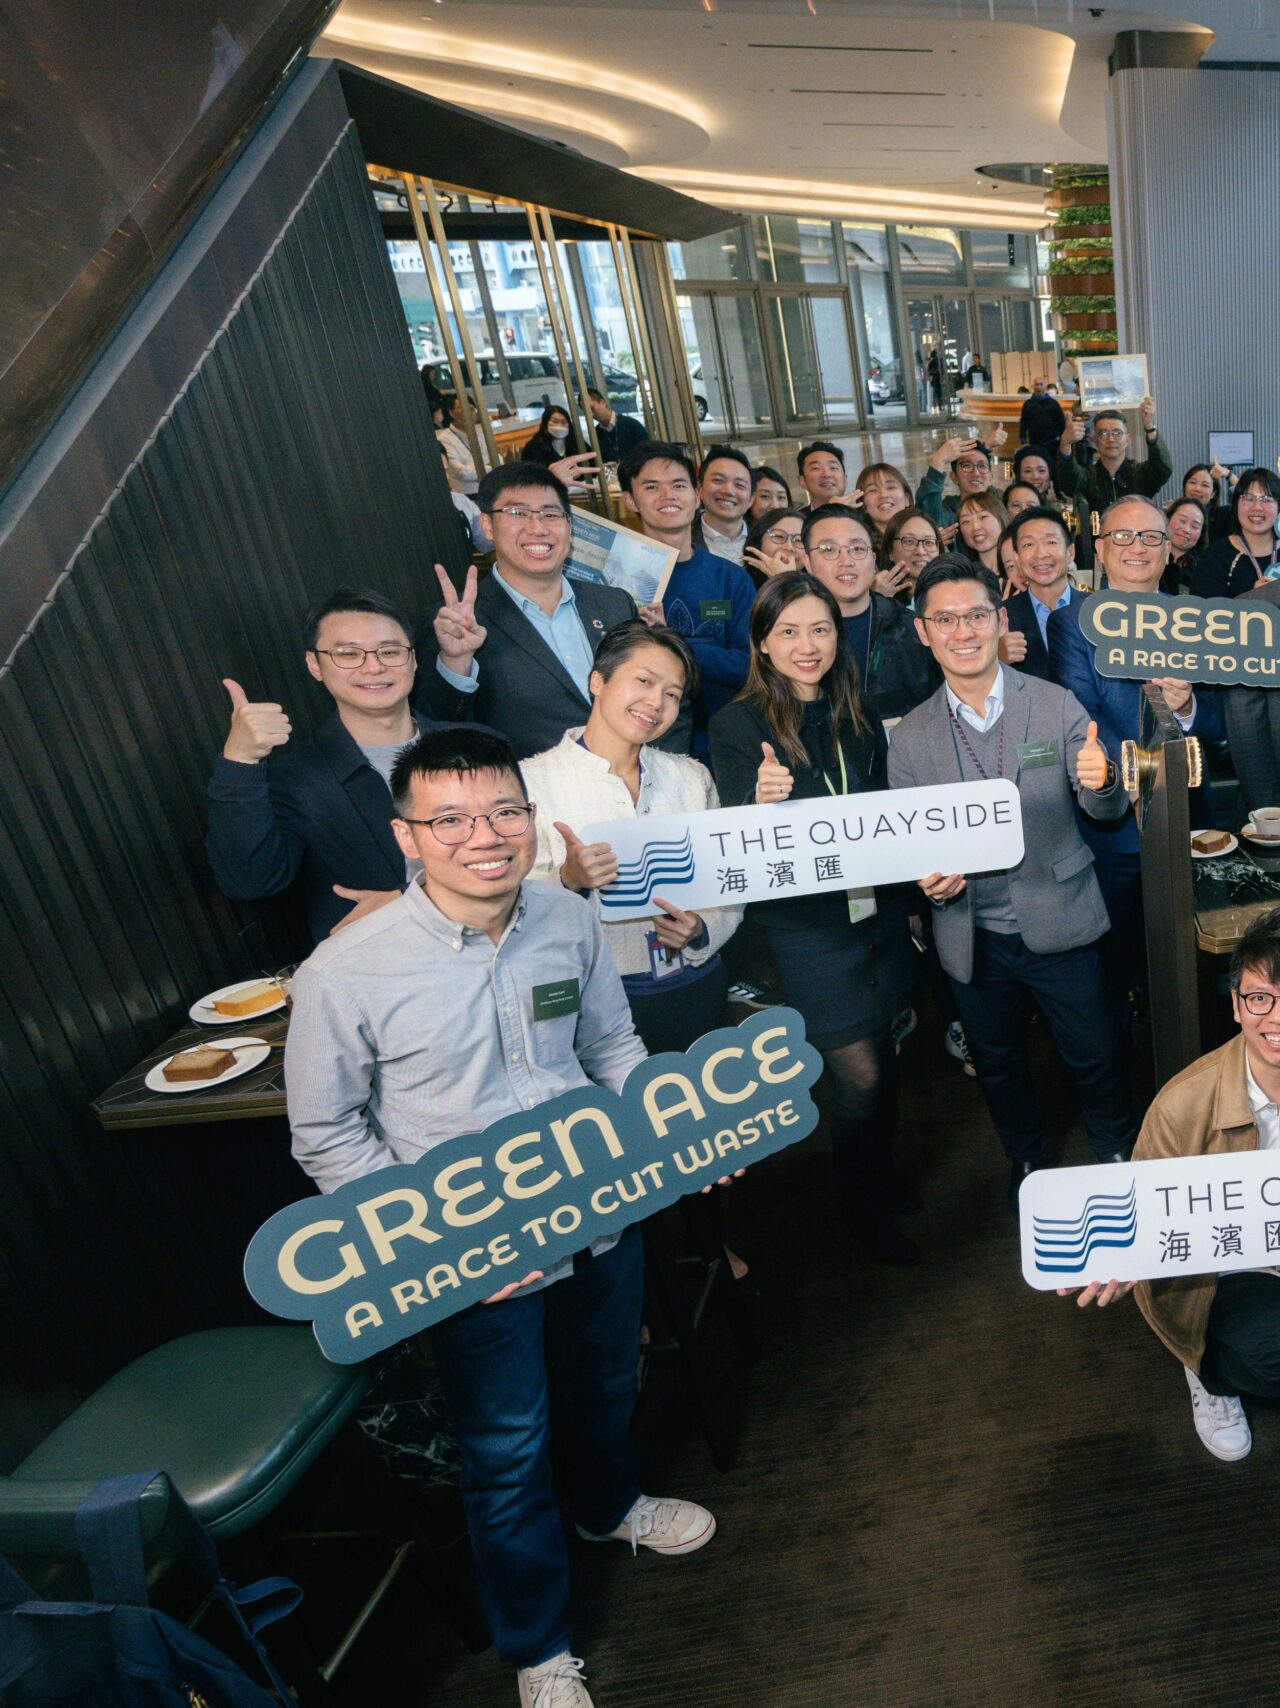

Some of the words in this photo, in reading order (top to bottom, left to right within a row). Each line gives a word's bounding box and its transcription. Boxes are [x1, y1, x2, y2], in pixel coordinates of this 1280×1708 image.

[1093, 602, 1273, 647] GREEN
[1109, 649, 1125, 665] A
[1134, 650, 1199, 669] RACE
[1204, 655, 1237, 672] TO
[709, 826, 795, 857] THE
[810, 801, 1012, 845] QUAYSIDE
[717, 855, 844, 895] 海濱匯
[278, 1109, 623, 1294] GREEN
[645, 1028, 804, 1137] ACE
[345, 1302, 382, 1337] A
[391, 1235, 519, 1313] RACE
[519, 1205, 582, 1246] TO
[591, 1160, 665, 1214] CUT
[673, 1100, 800, 1173] WASTE
[1155, 1181, 1245, 1217] THE
